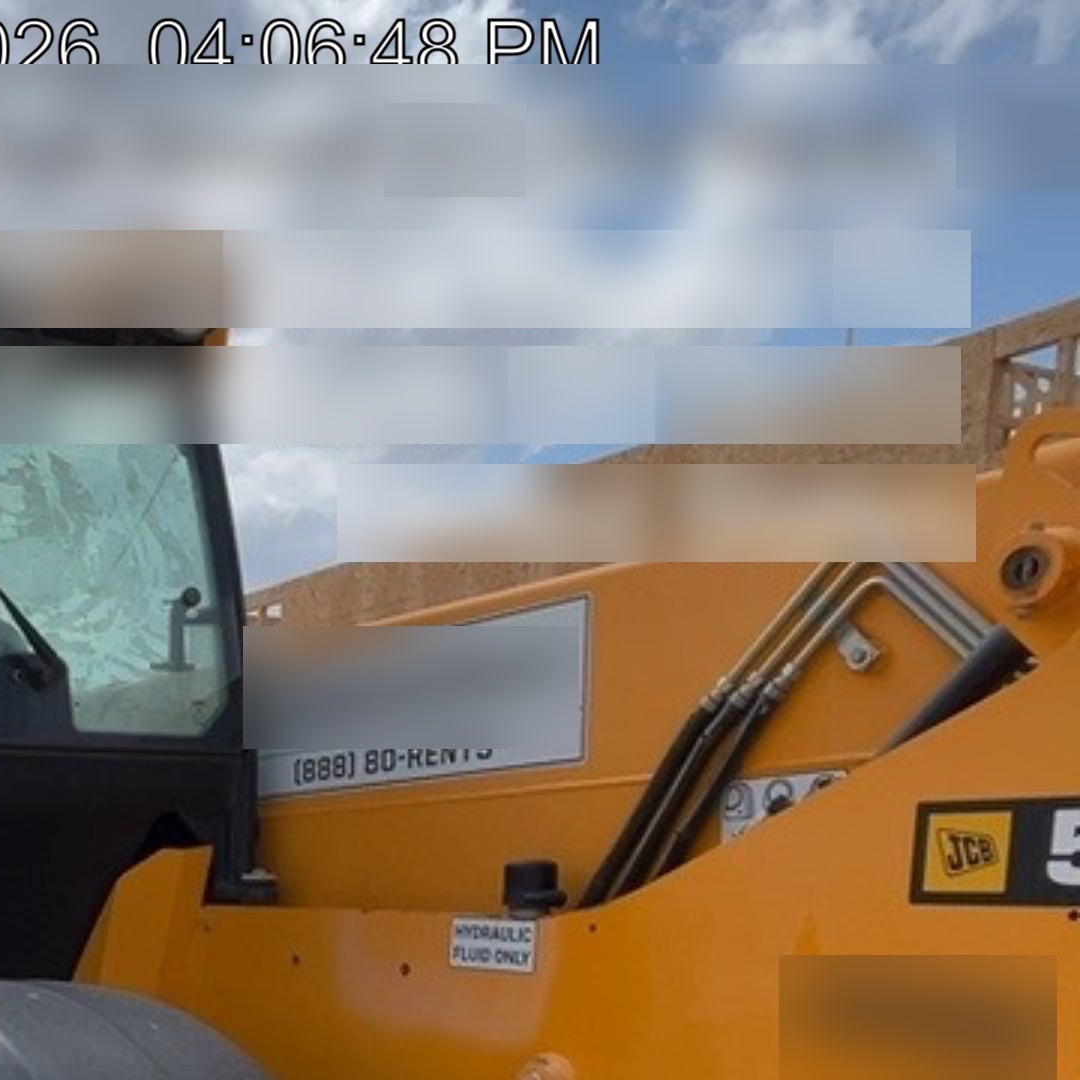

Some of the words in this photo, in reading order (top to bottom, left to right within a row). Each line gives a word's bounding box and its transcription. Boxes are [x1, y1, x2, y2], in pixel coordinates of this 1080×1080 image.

[946, 830, 994, 872] JCB
[455, 924, 532, 943] HYDRAULIC
[452, 946, 490, 964] FLUID
[494, 949, 532, 967] ONLY
